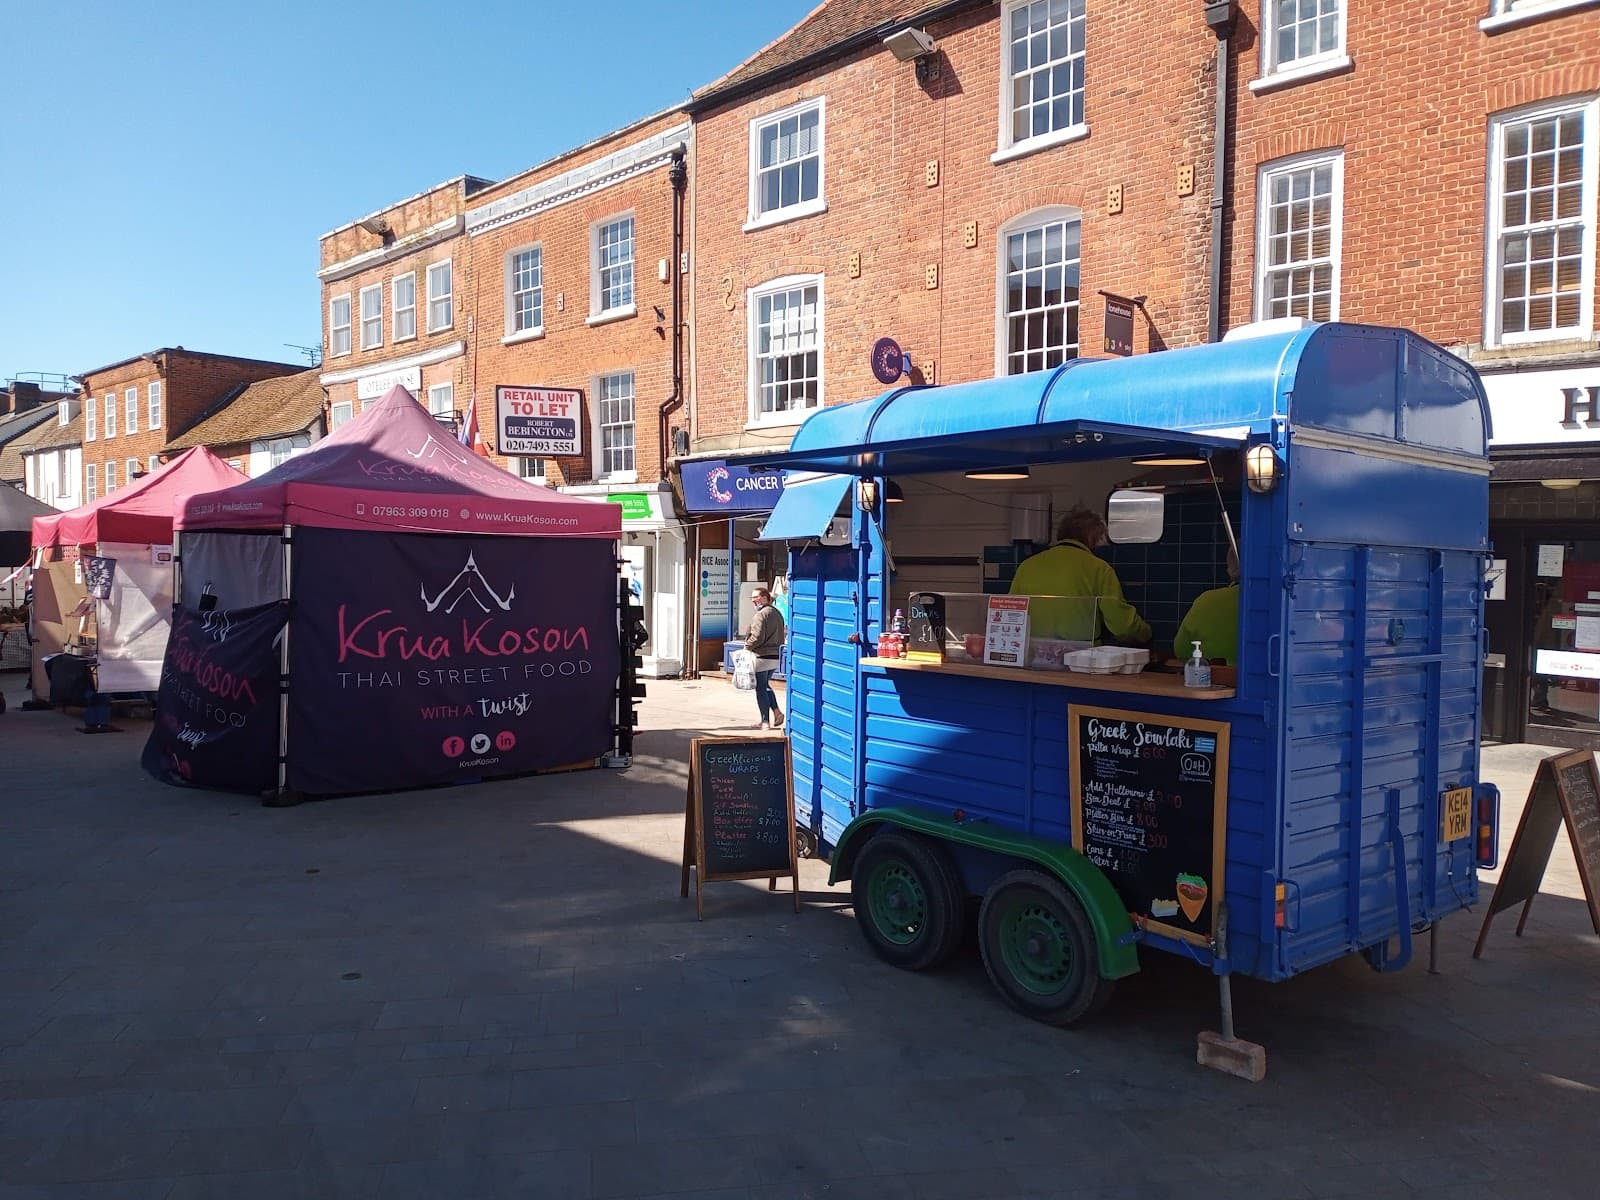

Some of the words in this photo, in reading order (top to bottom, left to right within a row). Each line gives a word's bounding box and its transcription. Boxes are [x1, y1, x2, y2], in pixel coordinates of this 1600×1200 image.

[504, 391, 544, 401] RETAIL
[548, 393, 574, 402] UNIT
[511, 402, 534, 415] TO
[539, 403, 568, 416] LET
[508, 426, 566, 437] BEBINGTON
[506, 441, 550, 451] 020-7493
[553, 442, 575, 452] 5551
[736, 476, 778, 490] CANCER
[372, 506, 406, 516] 07963
[408, 507, 428, 517] 309
[430, 508, 449, 518] 018
[476, 511, 578, 525] www.KruaKoson.com
[338, 604, 450, 662] Krua
[463, 618, 589, 656] Koson
[337, 672, 401, 688] THAI
[417, 666, 511, 686] STREET
[524, 660, 592, 680] FOOD
[421, 705, 458, 720] WITH
[464, 704, 474, 716] A
[477, 692, 533, 718] twist
[1088, 718, 1130, 742] Greek
[1133, 722, 1193, 749] Souvlaki
[459, 756, 499, 768] KruaKoson
[729, 764, 760, 774] WRAPS
[1085, 779, 1103, 793] Add
